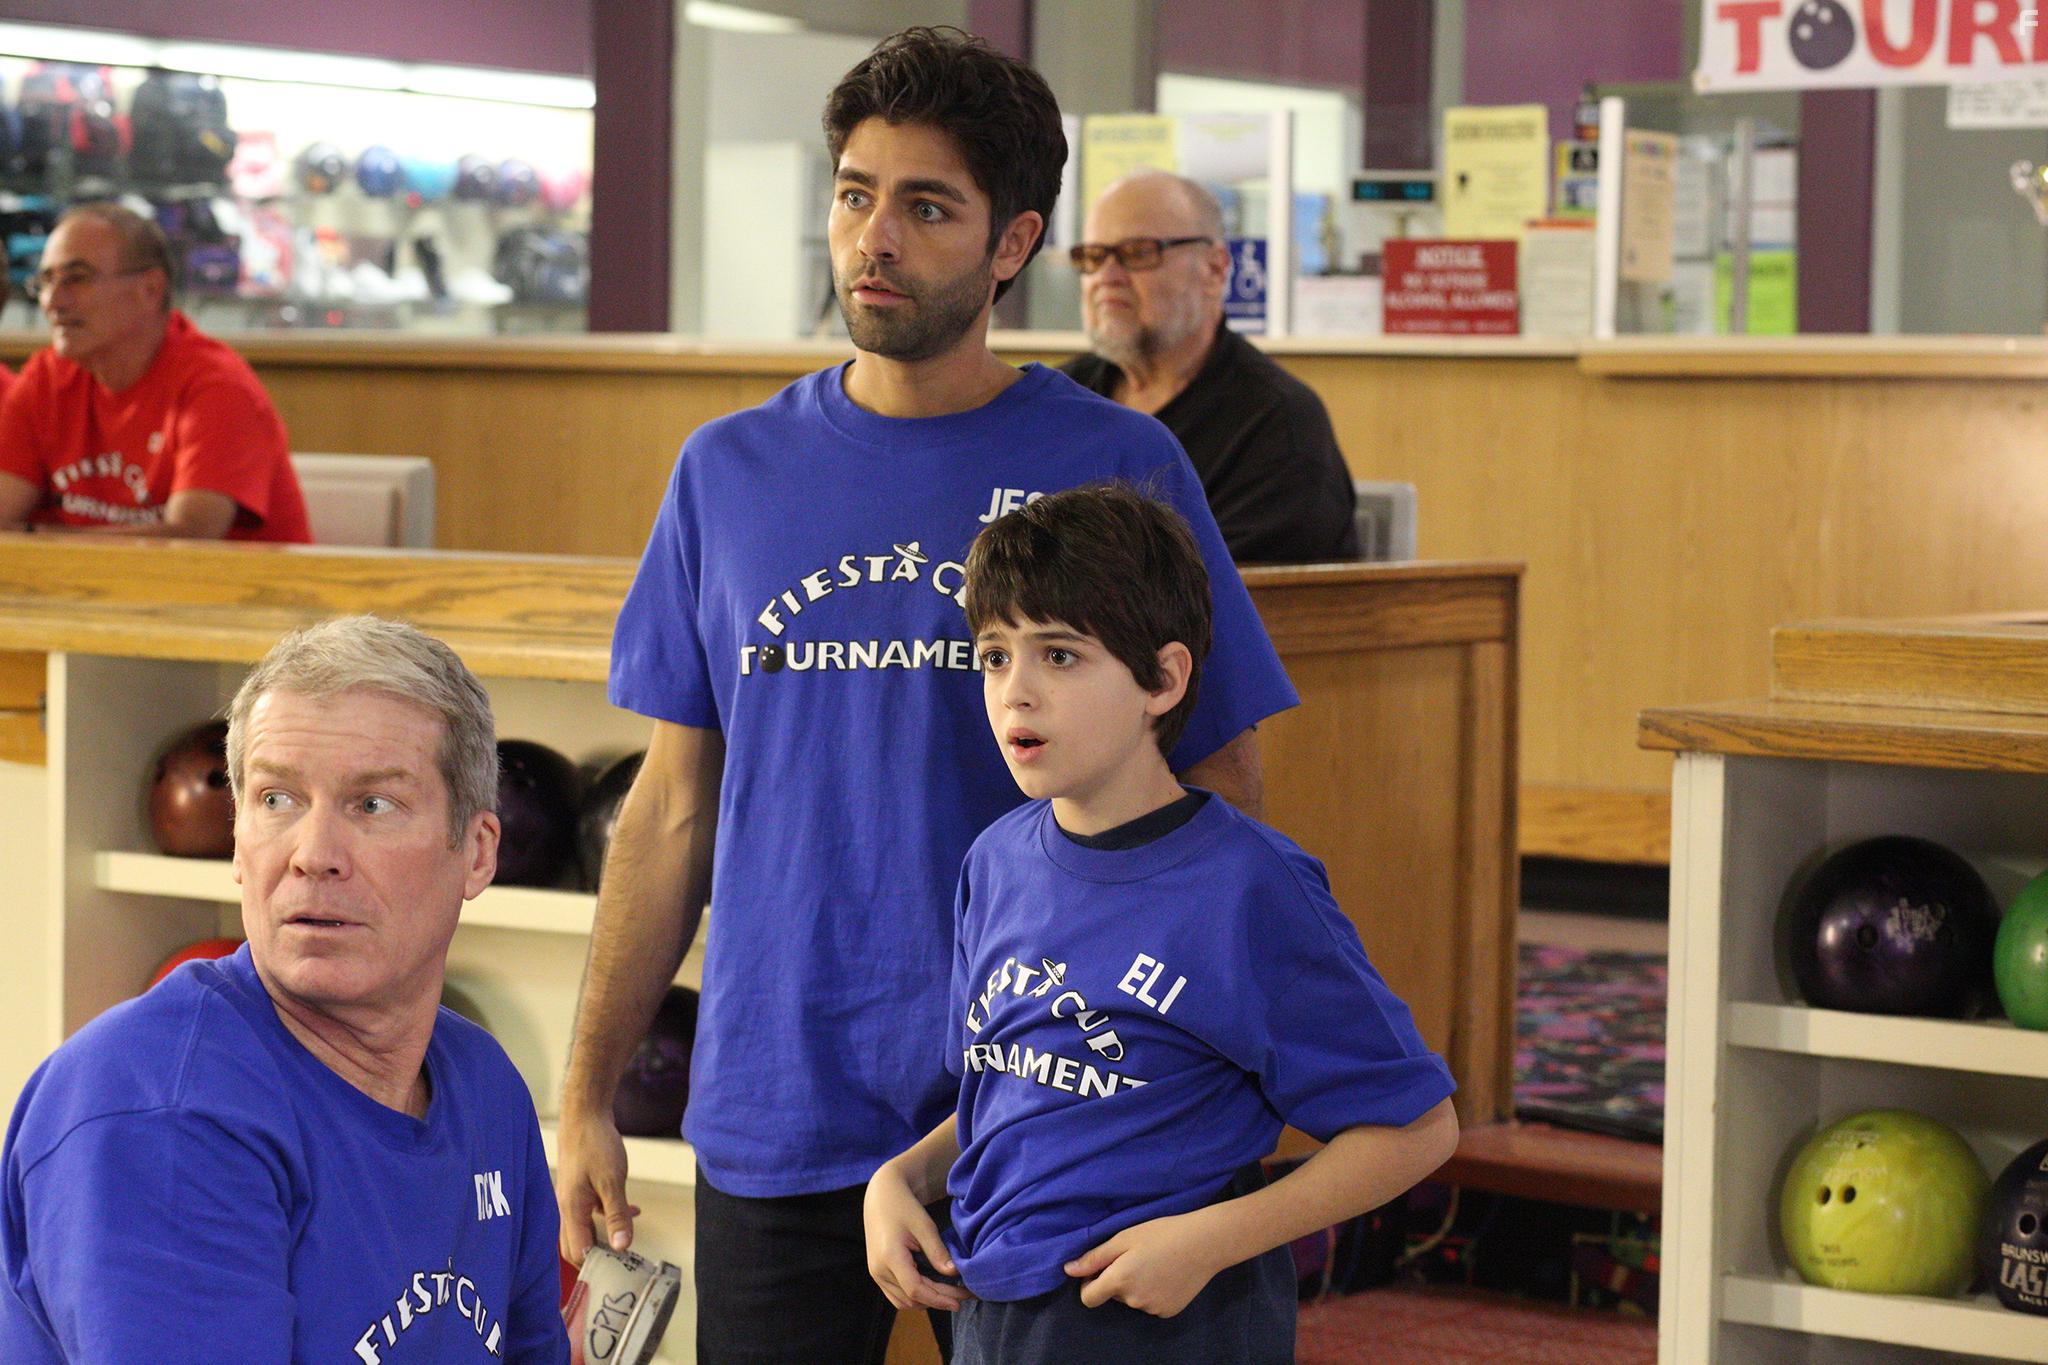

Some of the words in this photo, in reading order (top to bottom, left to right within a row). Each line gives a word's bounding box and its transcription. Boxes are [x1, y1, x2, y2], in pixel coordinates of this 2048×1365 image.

[758, 542, 928, 636] FIESTA
[966, 957, 1063, 1034] FIESTA
[1051, 991, 1124, 1060] CUP
[1117, 953, 1187, 1014] ELI
